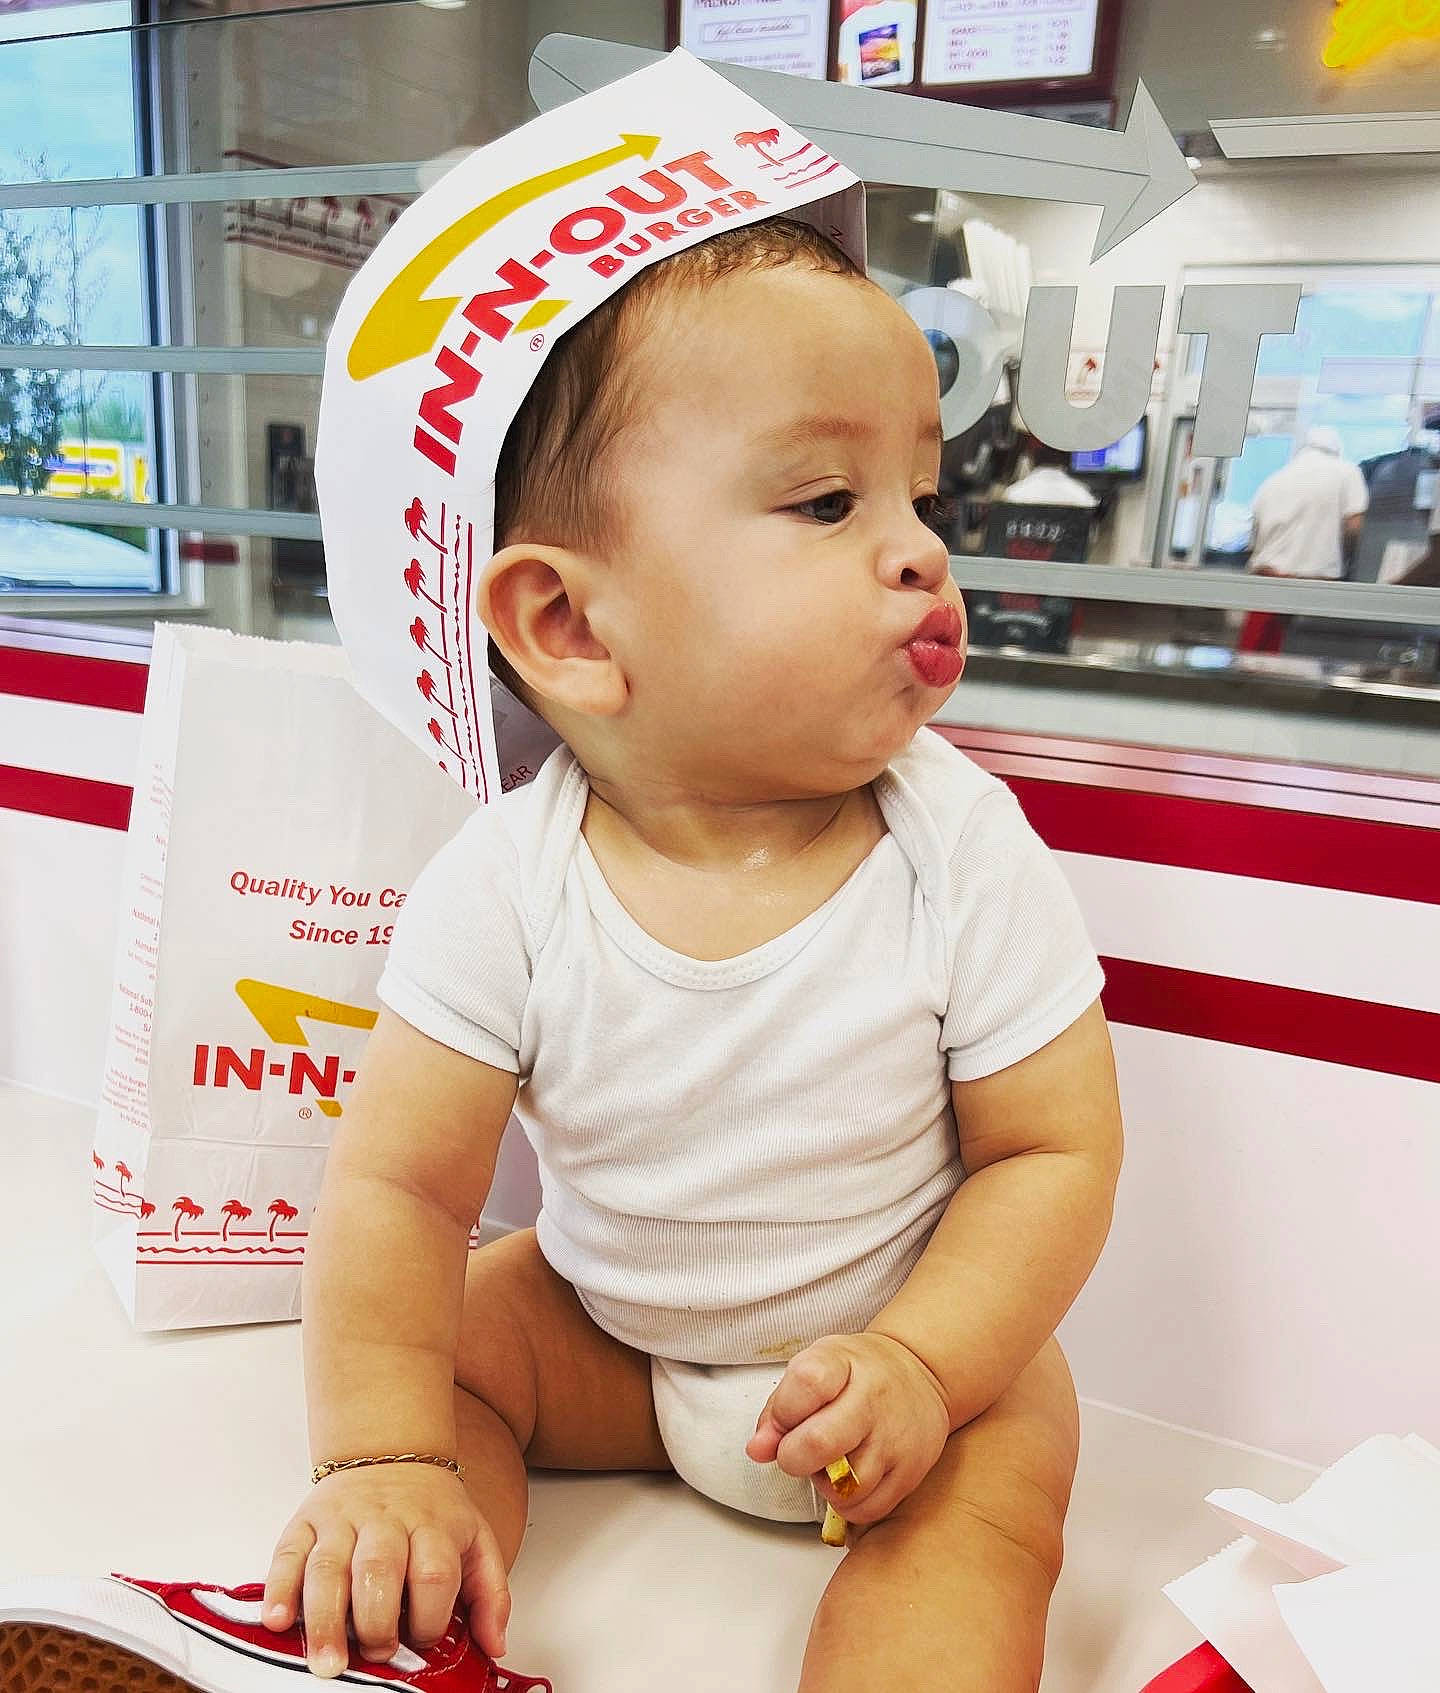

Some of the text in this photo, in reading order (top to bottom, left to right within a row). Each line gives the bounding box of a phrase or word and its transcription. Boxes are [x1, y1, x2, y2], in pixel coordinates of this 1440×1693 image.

[588, 189, 771, 279] BURGER
[413, 150, 735, 477] IN-N-OUT
[230, 871, 322, 906] Quality
[329, 885, 371, 907] You
[289, 919, 359, 945] Since
